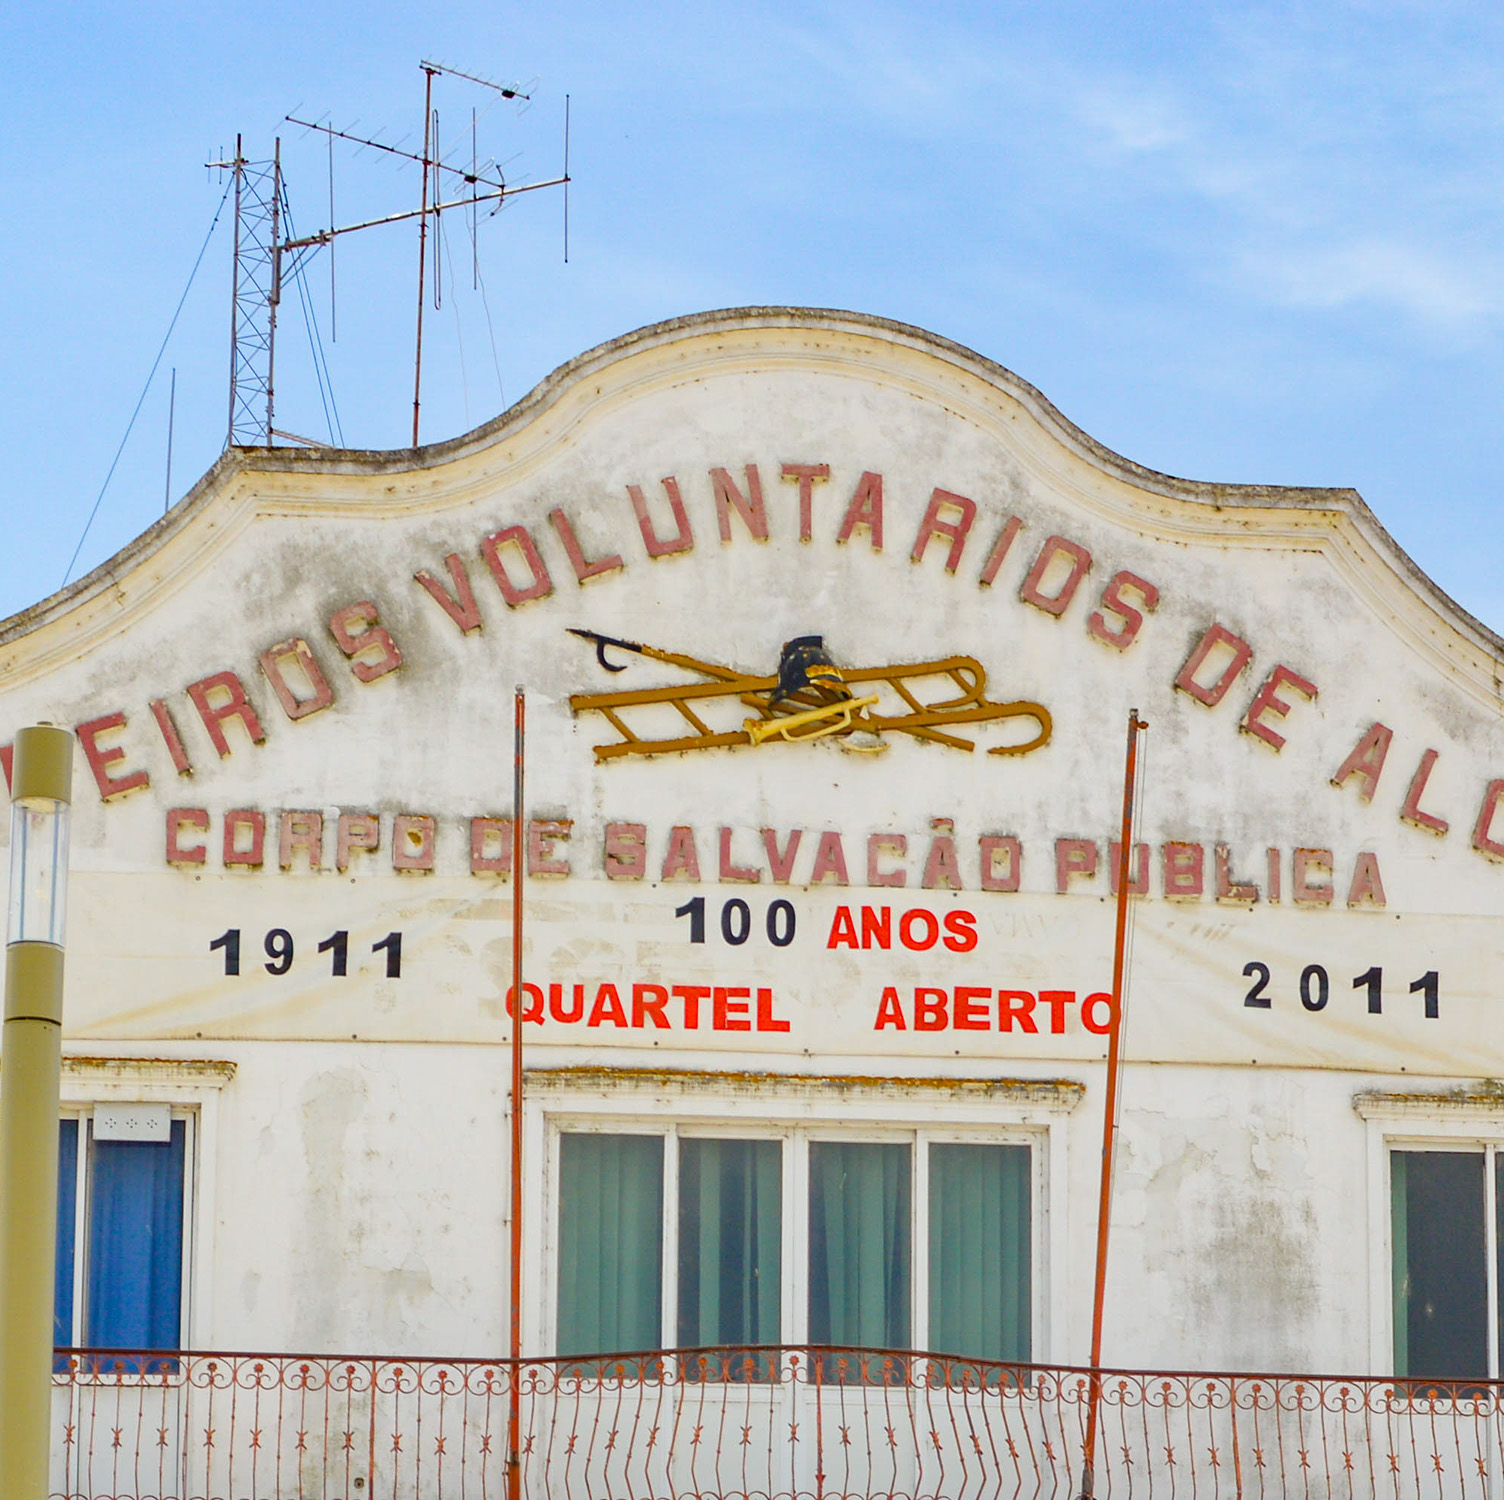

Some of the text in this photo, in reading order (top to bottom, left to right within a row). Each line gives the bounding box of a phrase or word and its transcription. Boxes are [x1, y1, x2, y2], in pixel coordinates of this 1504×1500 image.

[415, 463, 1159, 653] VOLUNTARIOS
[1174, 622, 1318, 752] DE
[166, 808, 435, 875] CORPO
[470, 815, 574, 879] DE
[1056, 837, 1387, 908] PUBLICA
[209, 927, 403, 978] 1911
[674, 896, 980, 954] 100 ANOS
[505, 982, 1122, 1036] QUARTEL ABERTO
[1241, 960, 1441, 1020] 2011
